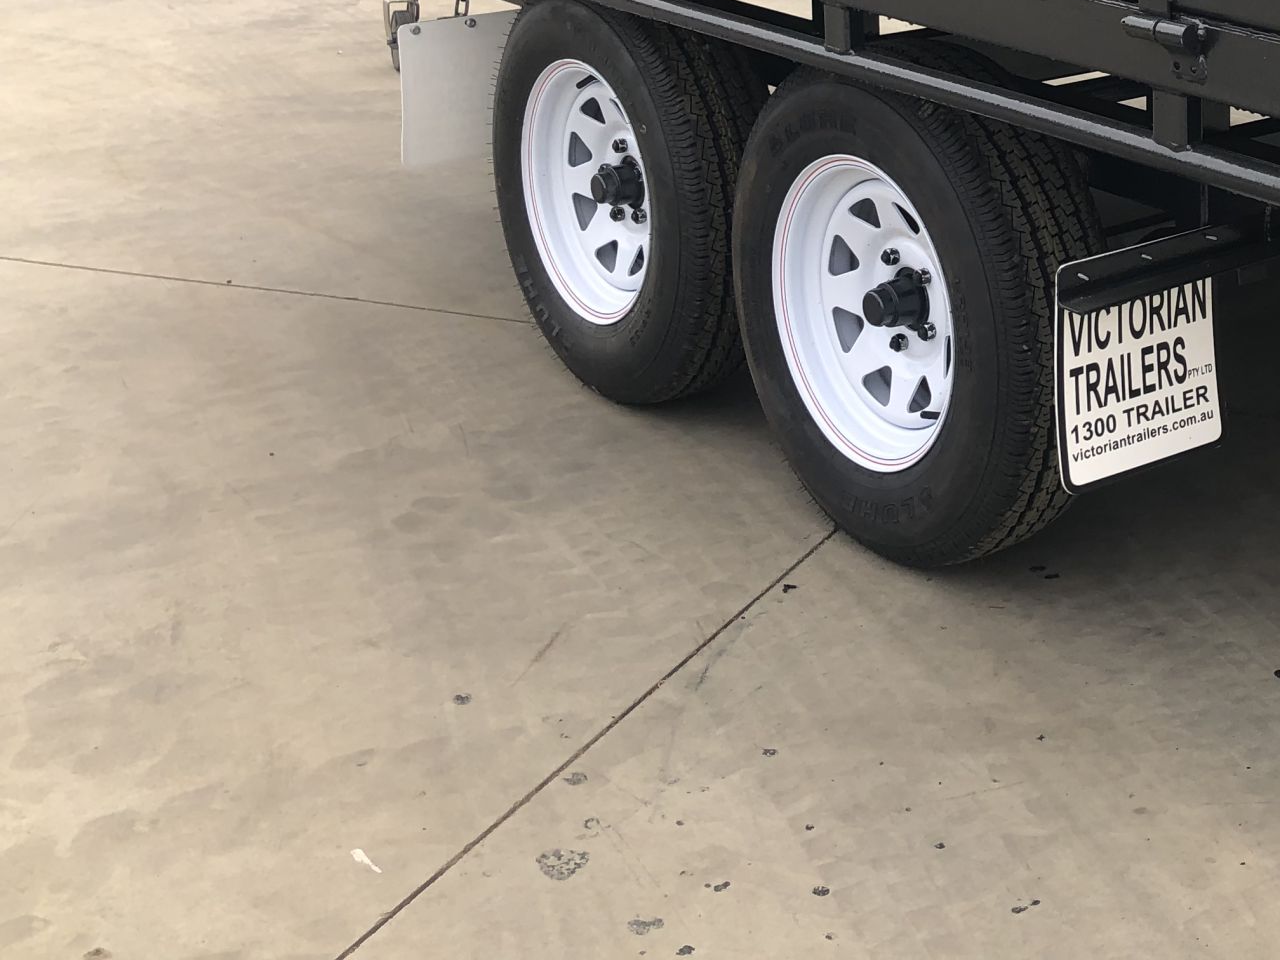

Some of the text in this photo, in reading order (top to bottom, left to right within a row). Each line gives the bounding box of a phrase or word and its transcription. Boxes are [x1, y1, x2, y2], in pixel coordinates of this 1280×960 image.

[1069, 278, 1207, 357] VICTORIAN
[1069, 336, 1213, 415] TRAILERS PTY LTD
[1070, 385, 1210, 444] 1300 TRAILER
[1072, 409, 1214, 462] victoriantrailers.com.au
